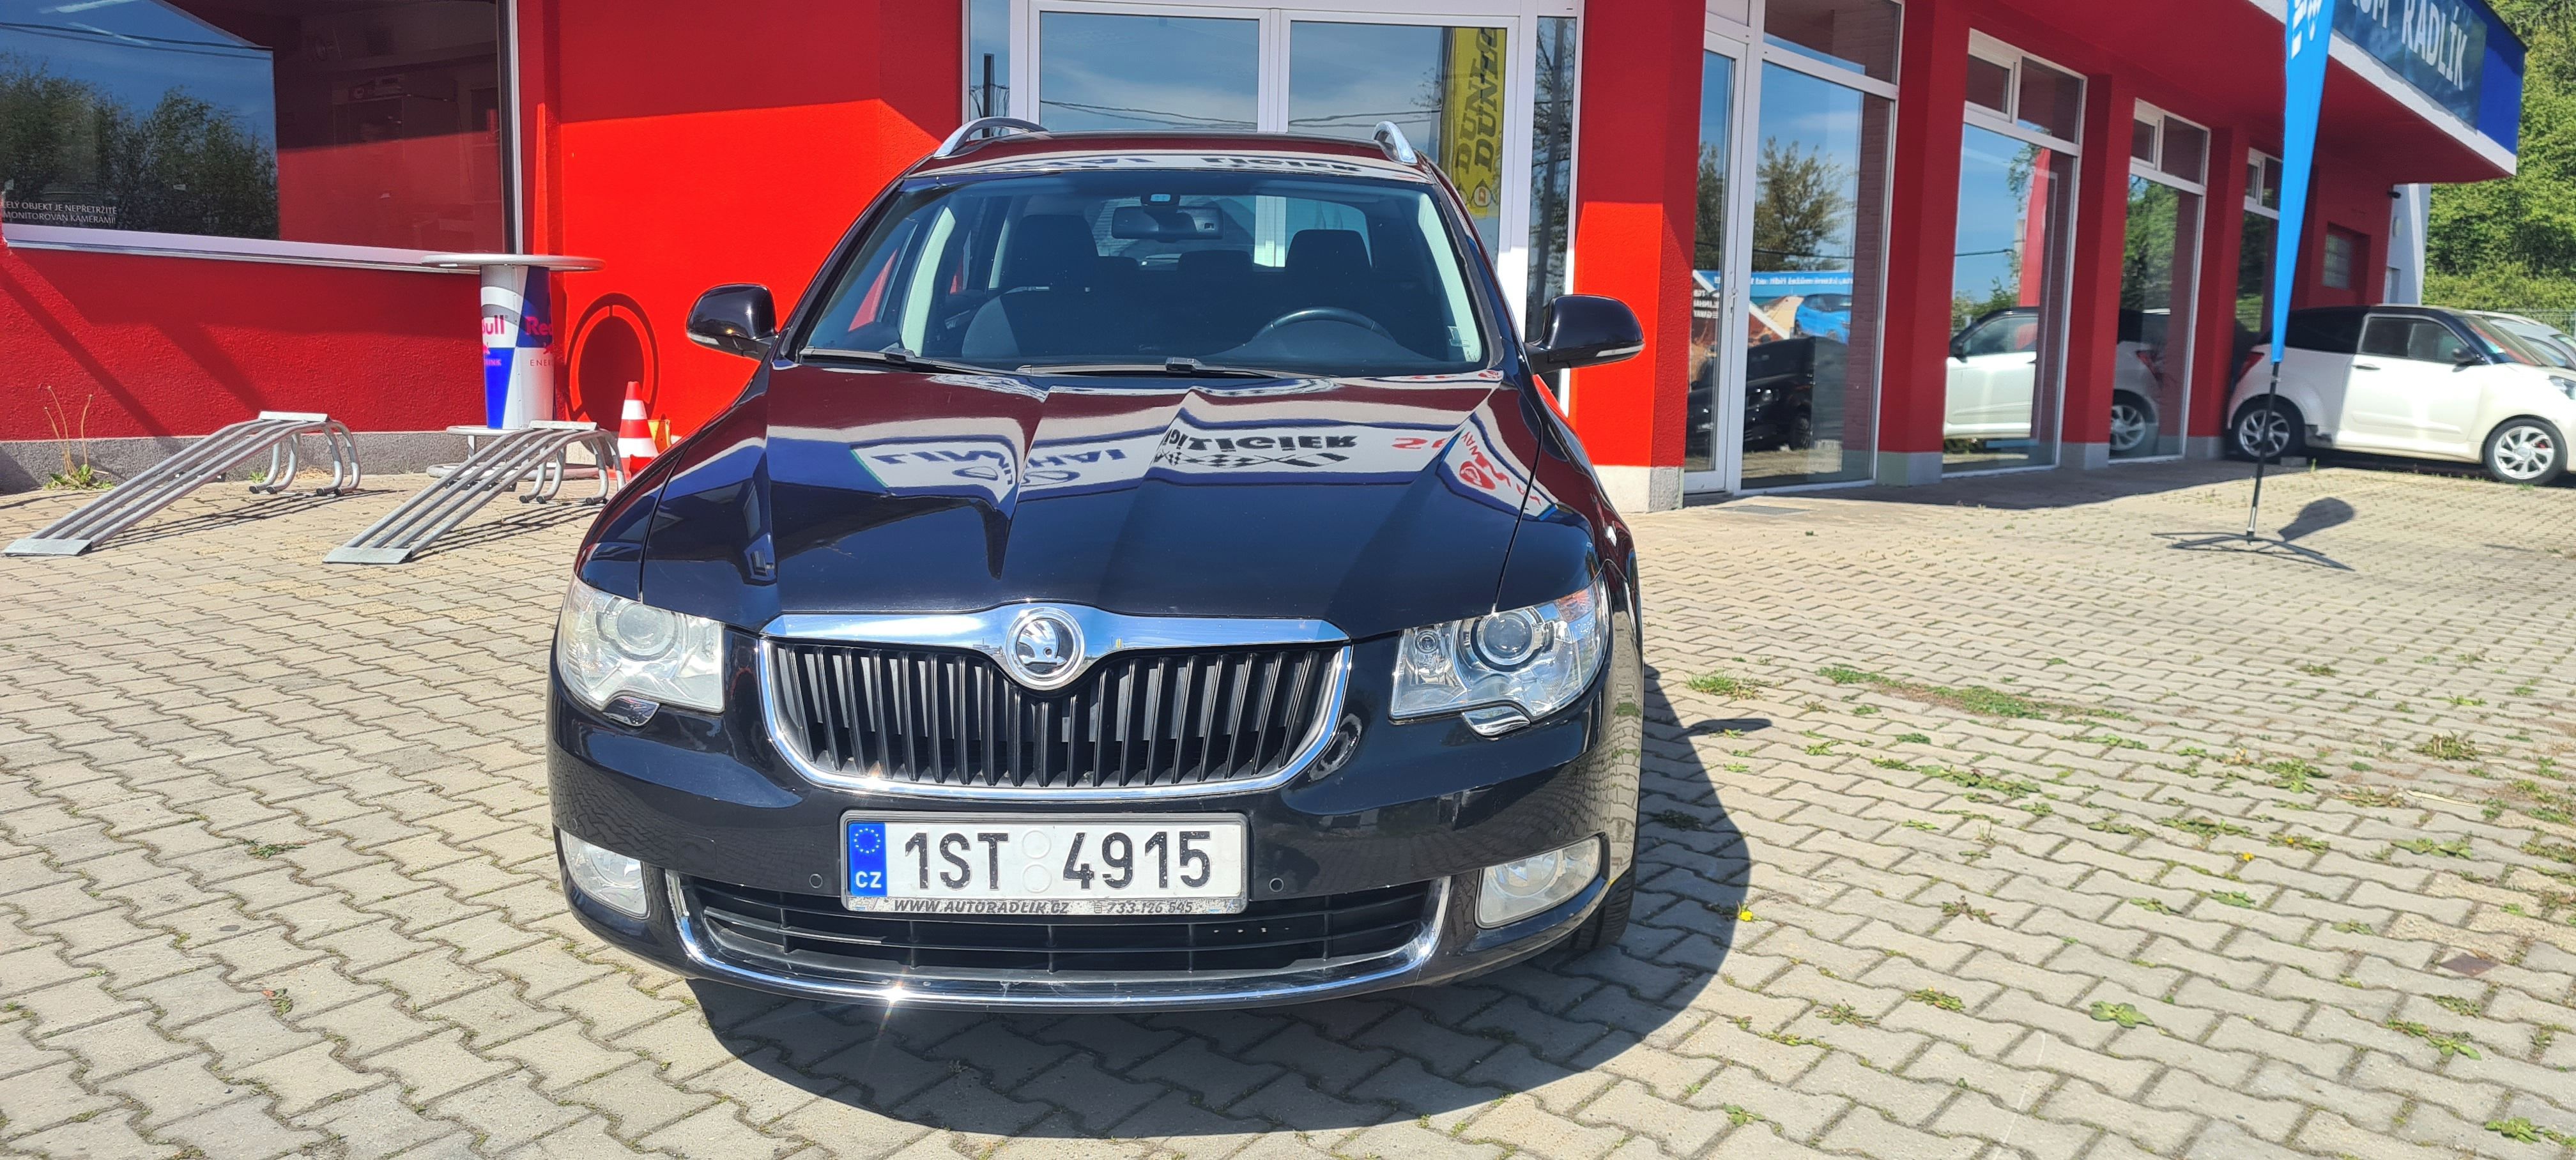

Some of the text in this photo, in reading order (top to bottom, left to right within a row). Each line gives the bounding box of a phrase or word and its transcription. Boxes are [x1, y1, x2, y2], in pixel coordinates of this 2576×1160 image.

[2402, 0, 2468, 91] RADLÍK
[22, 202, 52, 211] OBJEKT
[70, 215, 116, 224] KAMERAMI!
[905, 831, 1211, 890] 1ST 4915
[855, 873, 883, 889] CZ
